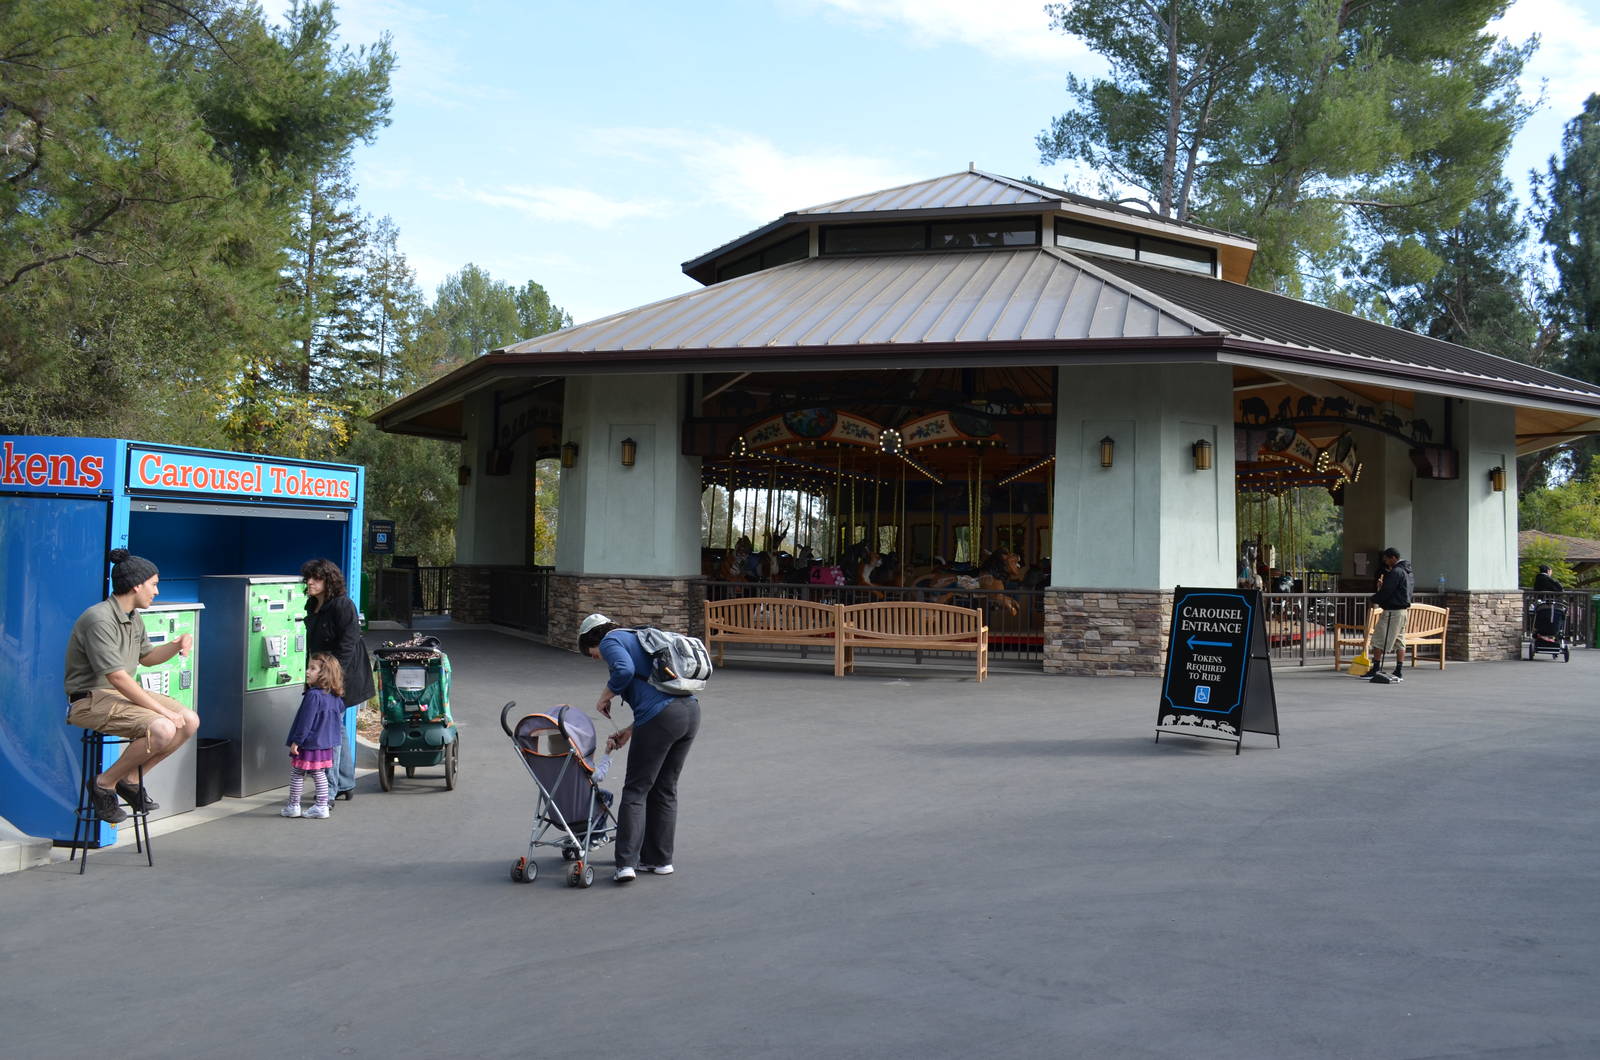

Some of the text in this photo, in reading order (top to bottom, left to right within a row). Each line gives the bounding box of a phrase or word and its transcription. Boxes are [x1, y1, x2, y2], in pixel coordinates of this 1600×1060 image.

[0, 441, 104, 488] kens
[139, 454, 350, 499] Carousel Tokens
[1182, 606, 1243, 620] CAROUSEL
[1181, 620, 1242, 634] ENTRANCE
[1192, 653, 1222, 663] TOKENS
[1186, 662, 1226, 673] REQUIRED
[1189, 672, 1222, 682] TO RIDE
